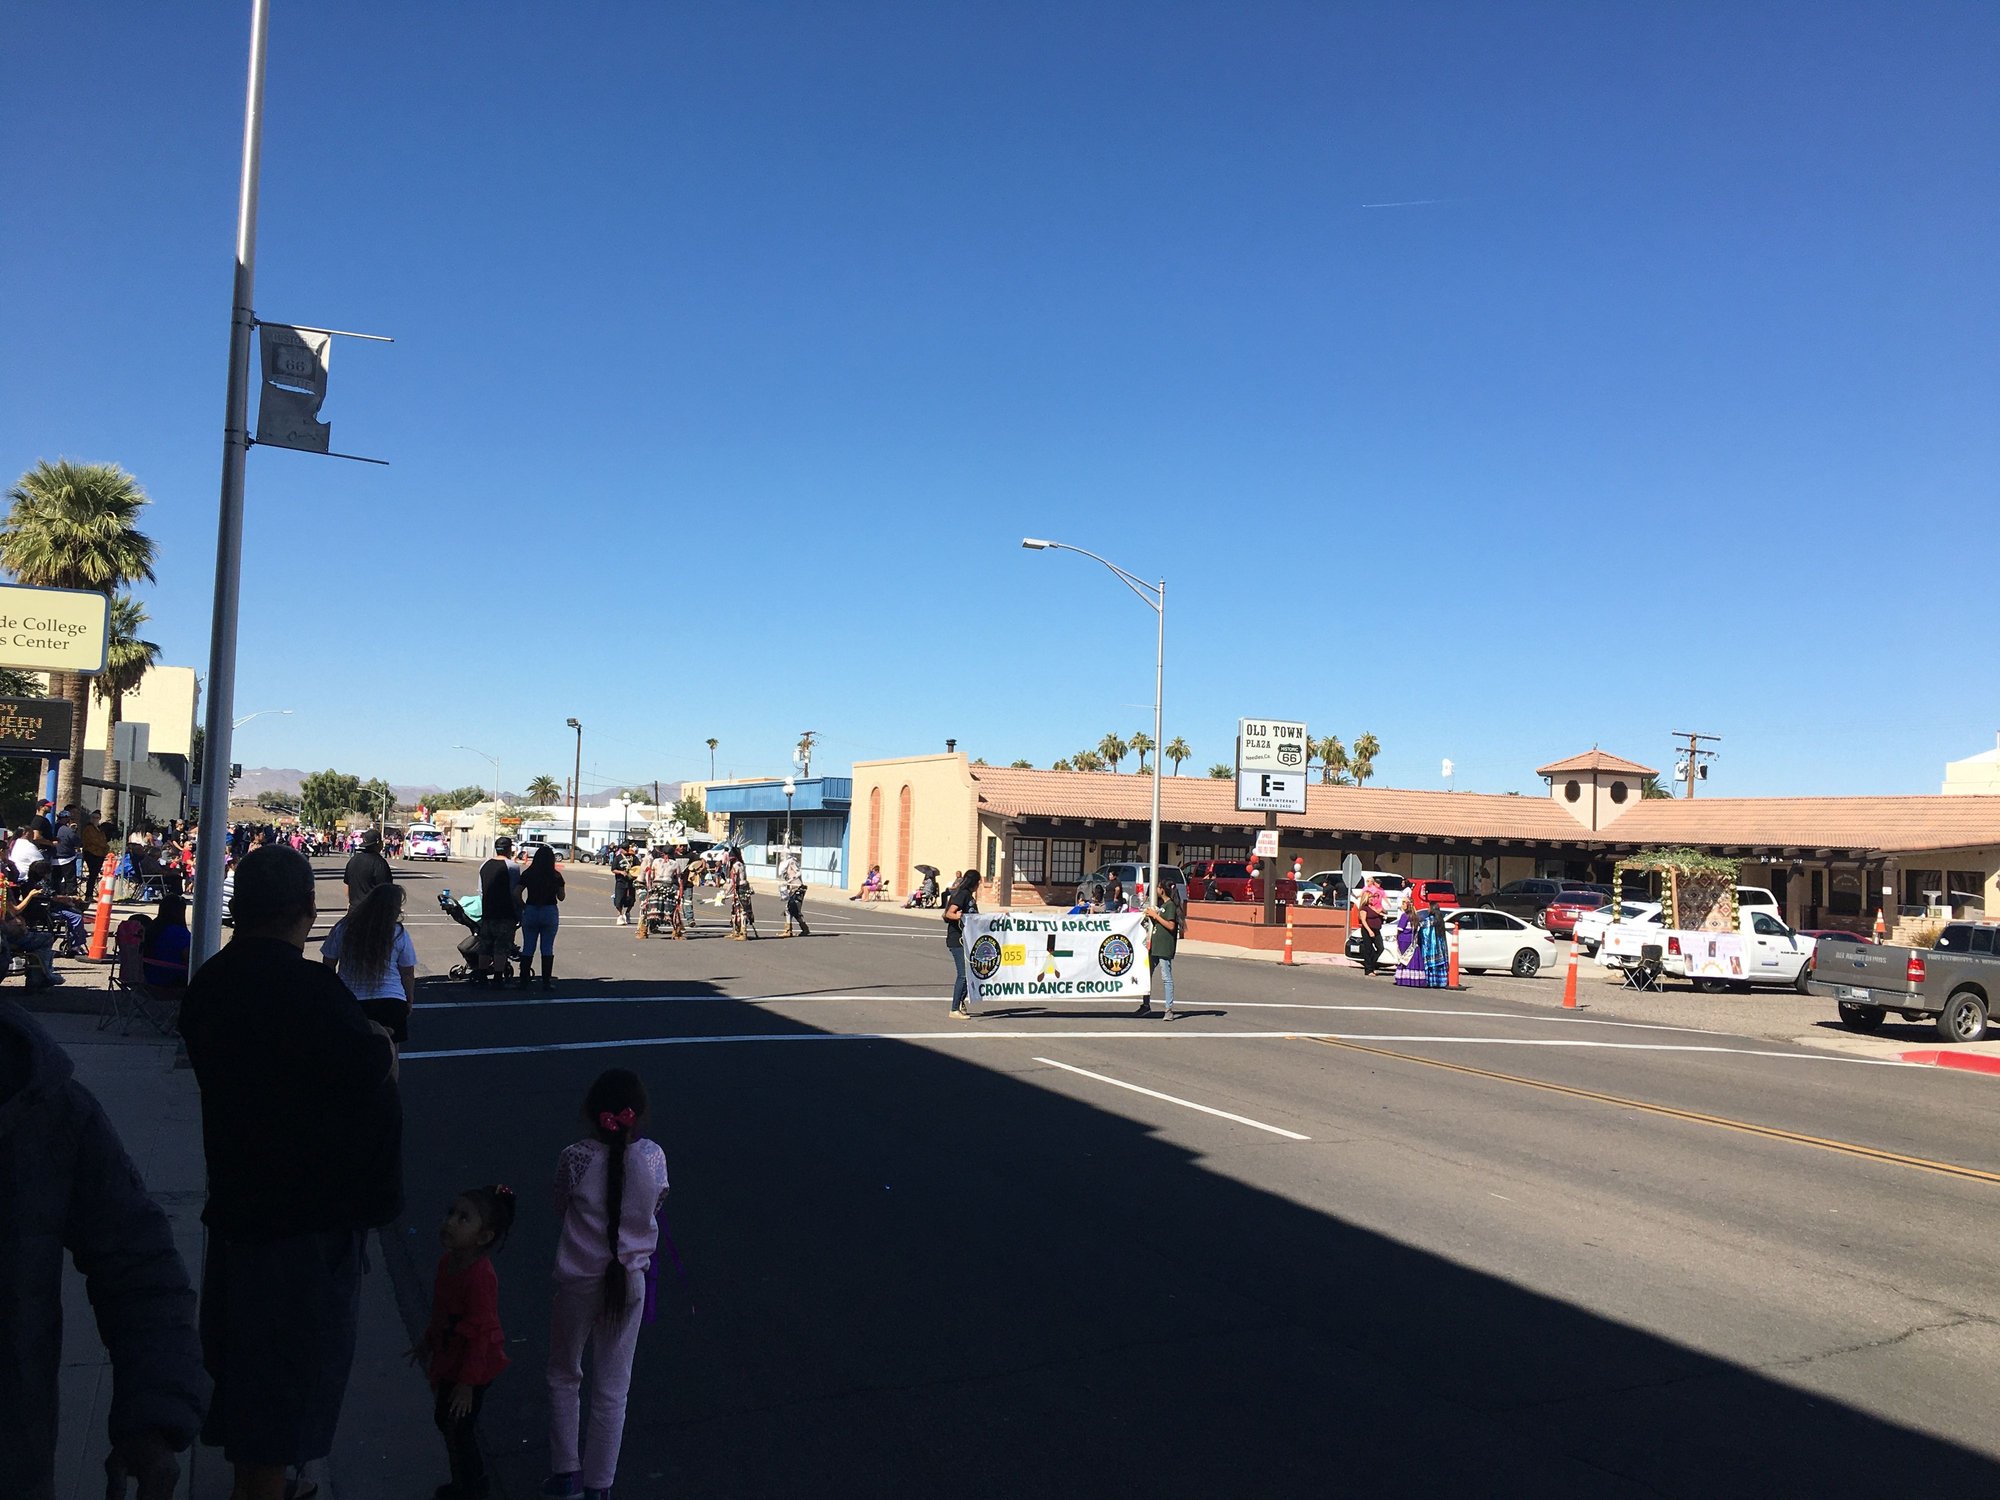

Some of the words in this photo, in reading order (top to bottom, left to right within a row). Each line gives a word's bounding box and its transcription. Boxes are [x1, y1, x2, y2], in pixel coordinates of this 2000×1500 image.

[286, 359, 305, 372] 66
[0, 615, 17, 629] de
[23, 617, 87, 637] College
[13, 634, 70, 650] Center
[1246, 723, 1267, 737] OLD
[1272, 725, 1303, 739] TOWN
[1246, 739, 1271, 749] PLAZA
[1282, 753, 1297, 762] 66
[1062, 920, 1112, 932] APACHE
[1004, 951, 1022, 962] 055
[978, 981, 1024, 997] CROWN
[1028, 981, 1073, 995] DANCE
[1076, 981, 1123, 994] GROUP
